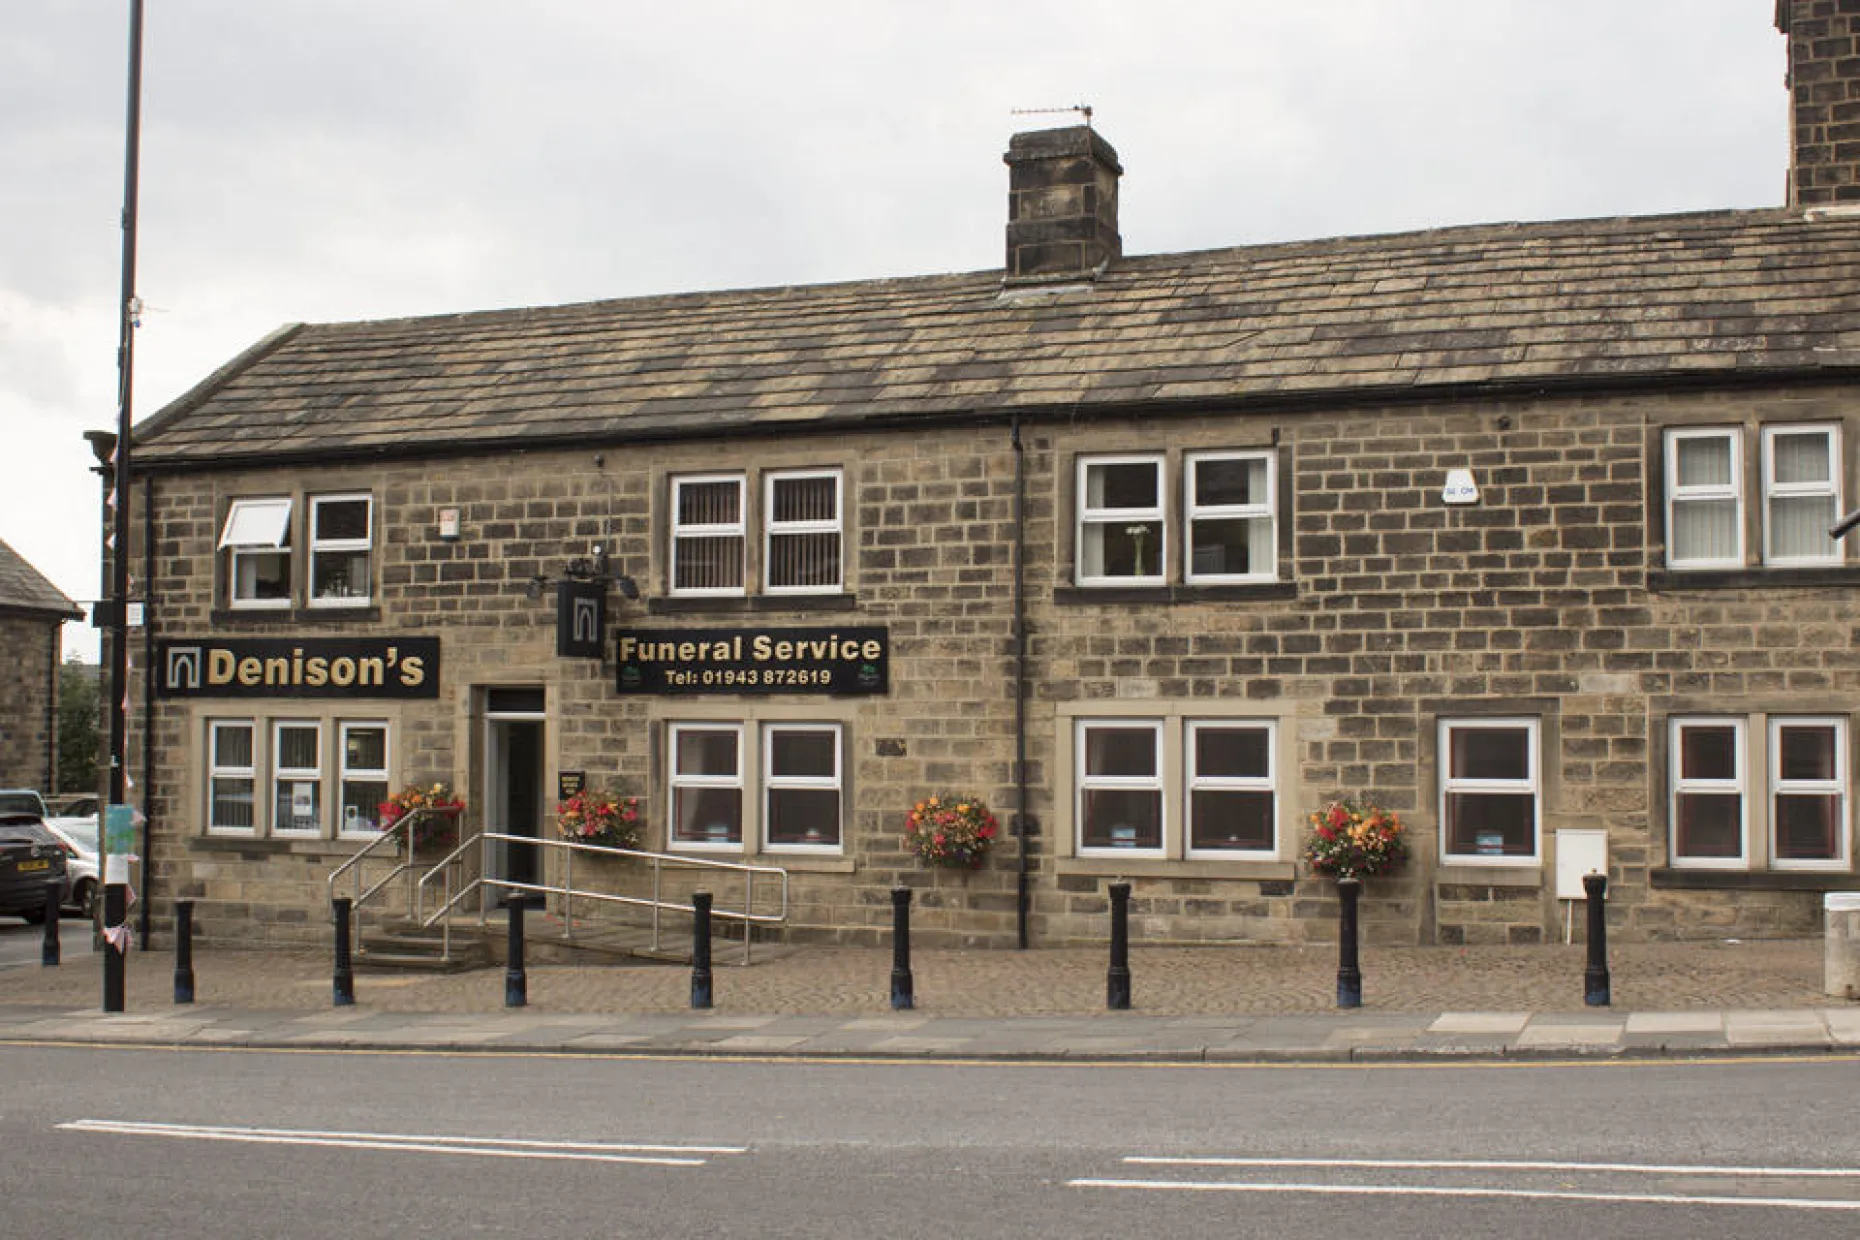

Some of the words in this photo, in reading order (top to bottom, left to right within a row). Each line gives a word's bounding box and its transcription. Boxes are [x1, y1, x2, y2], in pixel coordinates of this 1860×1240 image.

[619, 635, 742, 662] Funeral
[752, 634, 881, 661] Service
[207, 646, 425, 686] Denison's
[665, 670, 698, 685] Tel:
[702, 670, 759, 685] 01943
[762, 669, 832, 684] 872619
